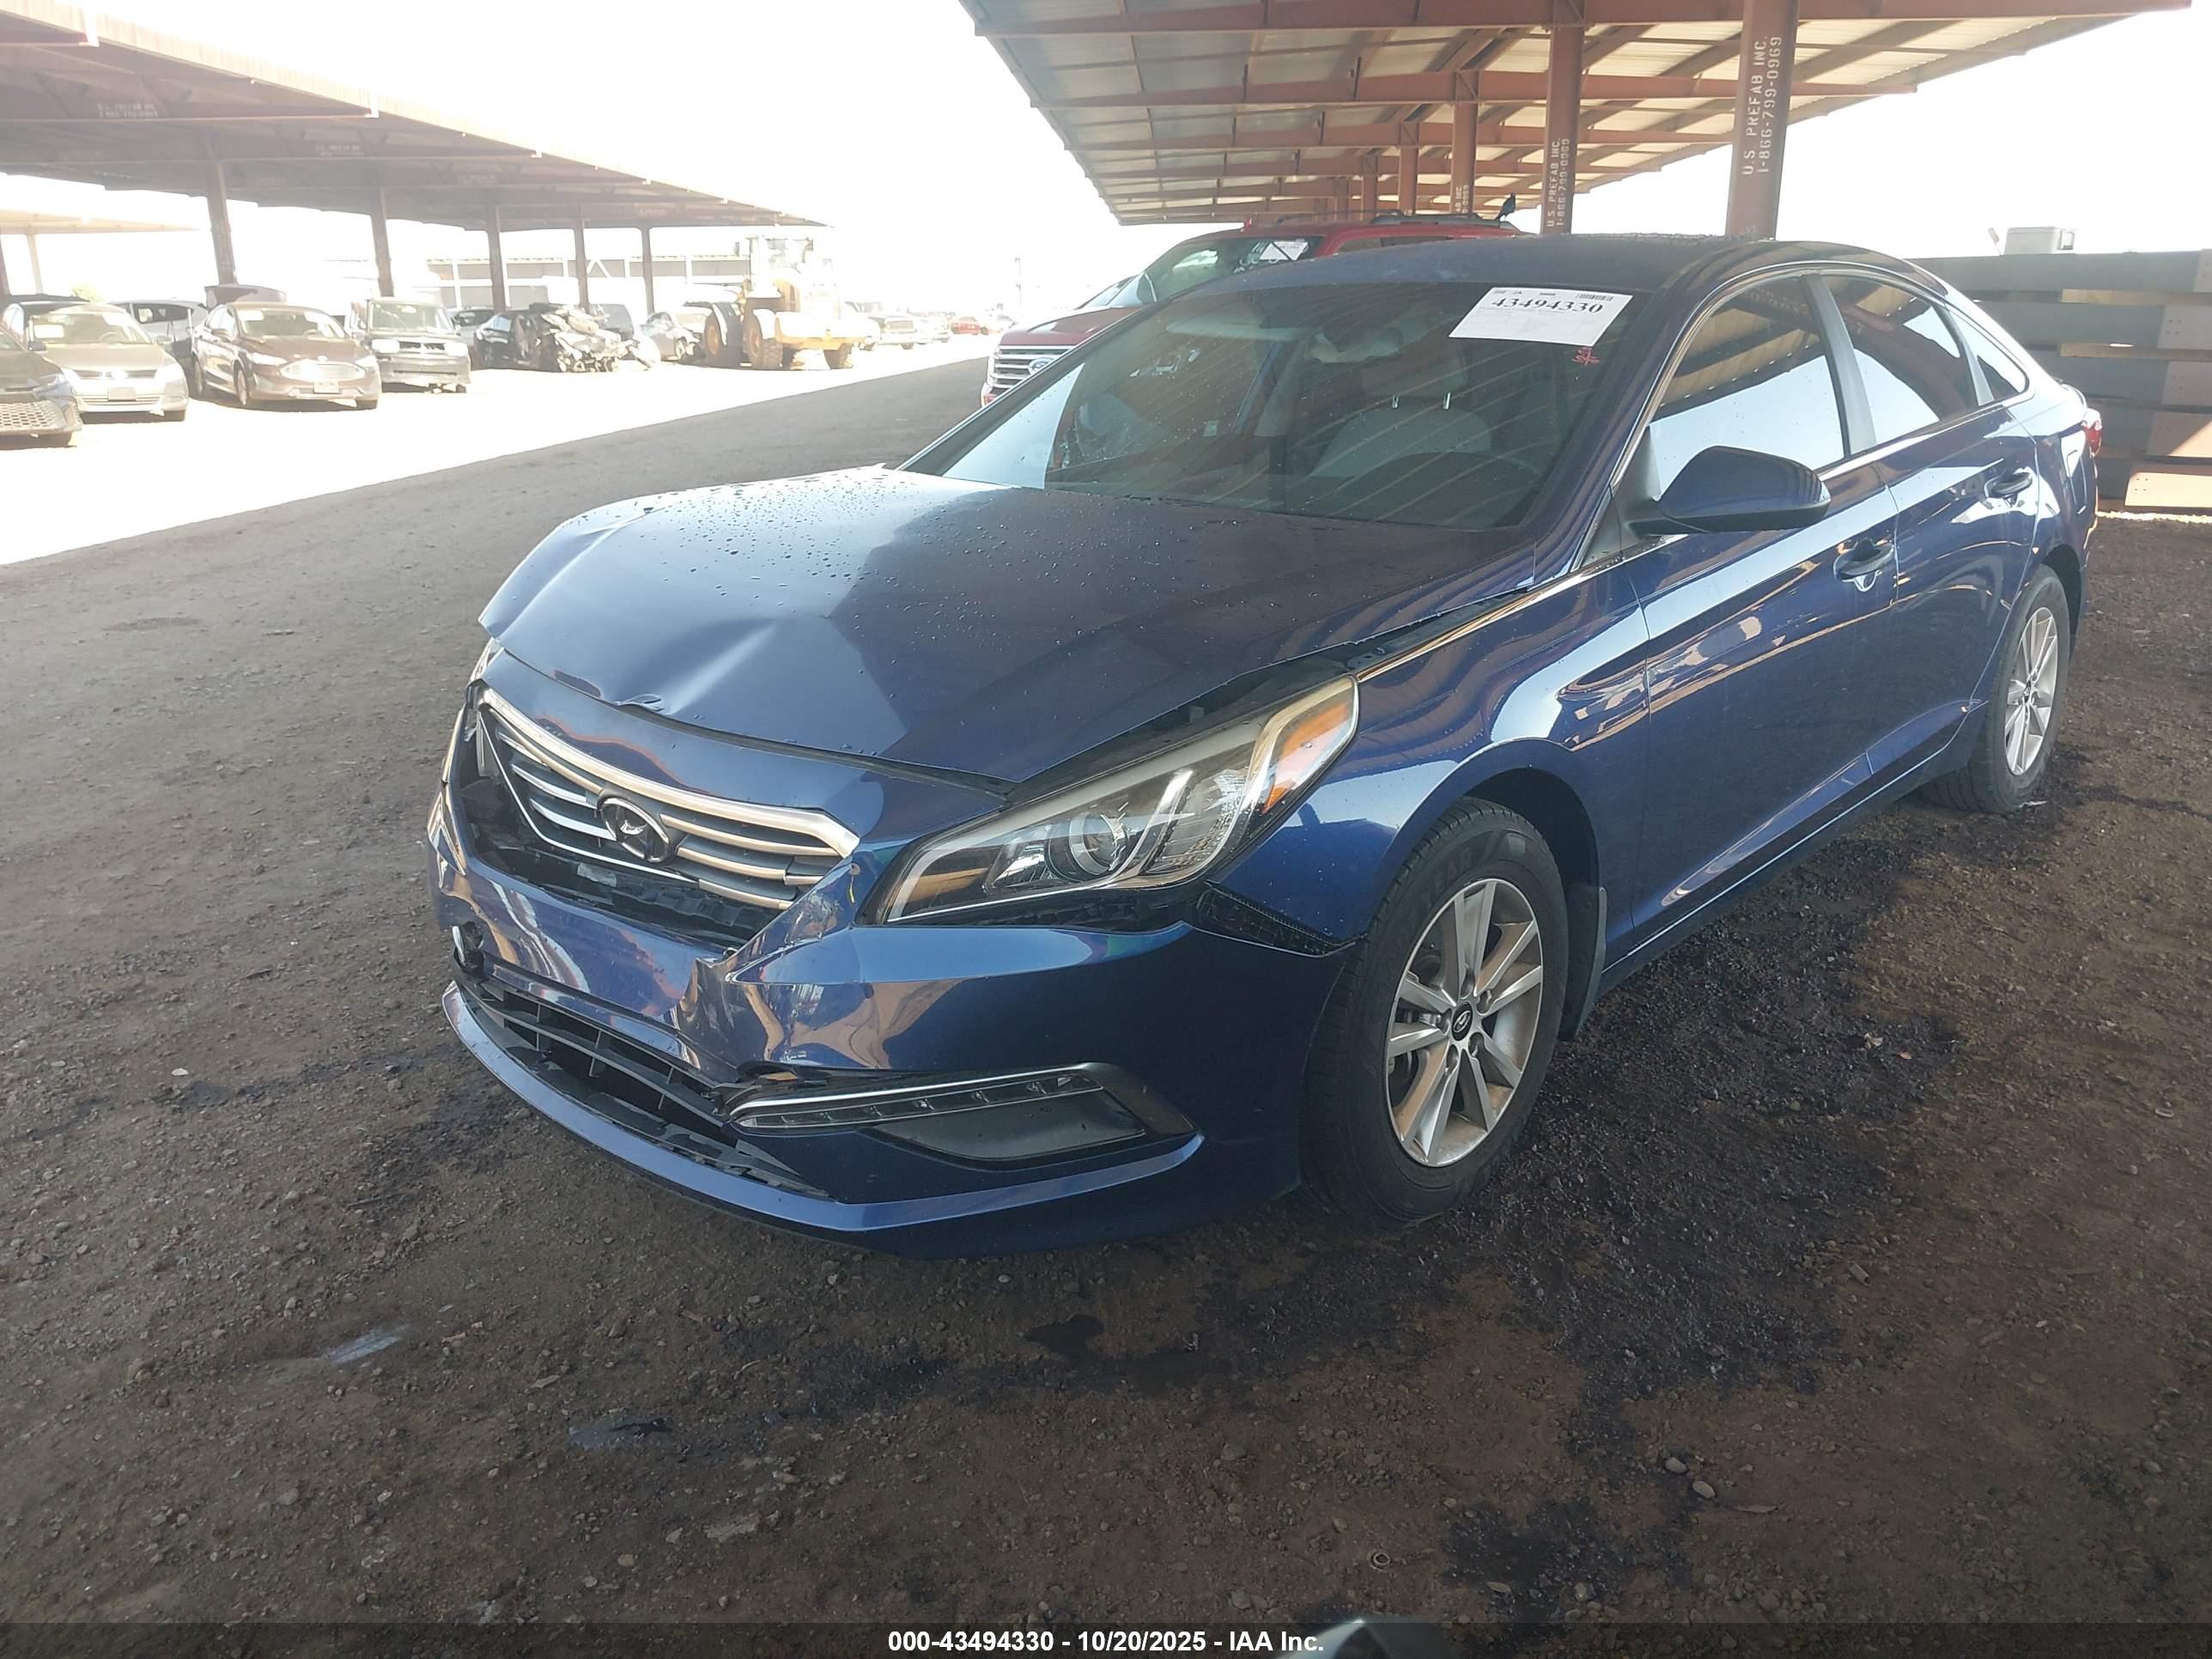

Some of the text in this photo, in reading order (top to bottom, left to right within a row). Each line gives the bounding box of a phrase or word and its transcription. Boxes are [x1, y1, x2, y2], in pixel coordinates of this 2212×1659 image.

[1746, 76, 1764, 137] PREFAB
[1757, 36, 1783, 173] 1-866-799-0969
[1548, 162, 1559, 202] PREFAB
[1492, 297, 1603, 313] 43494330
